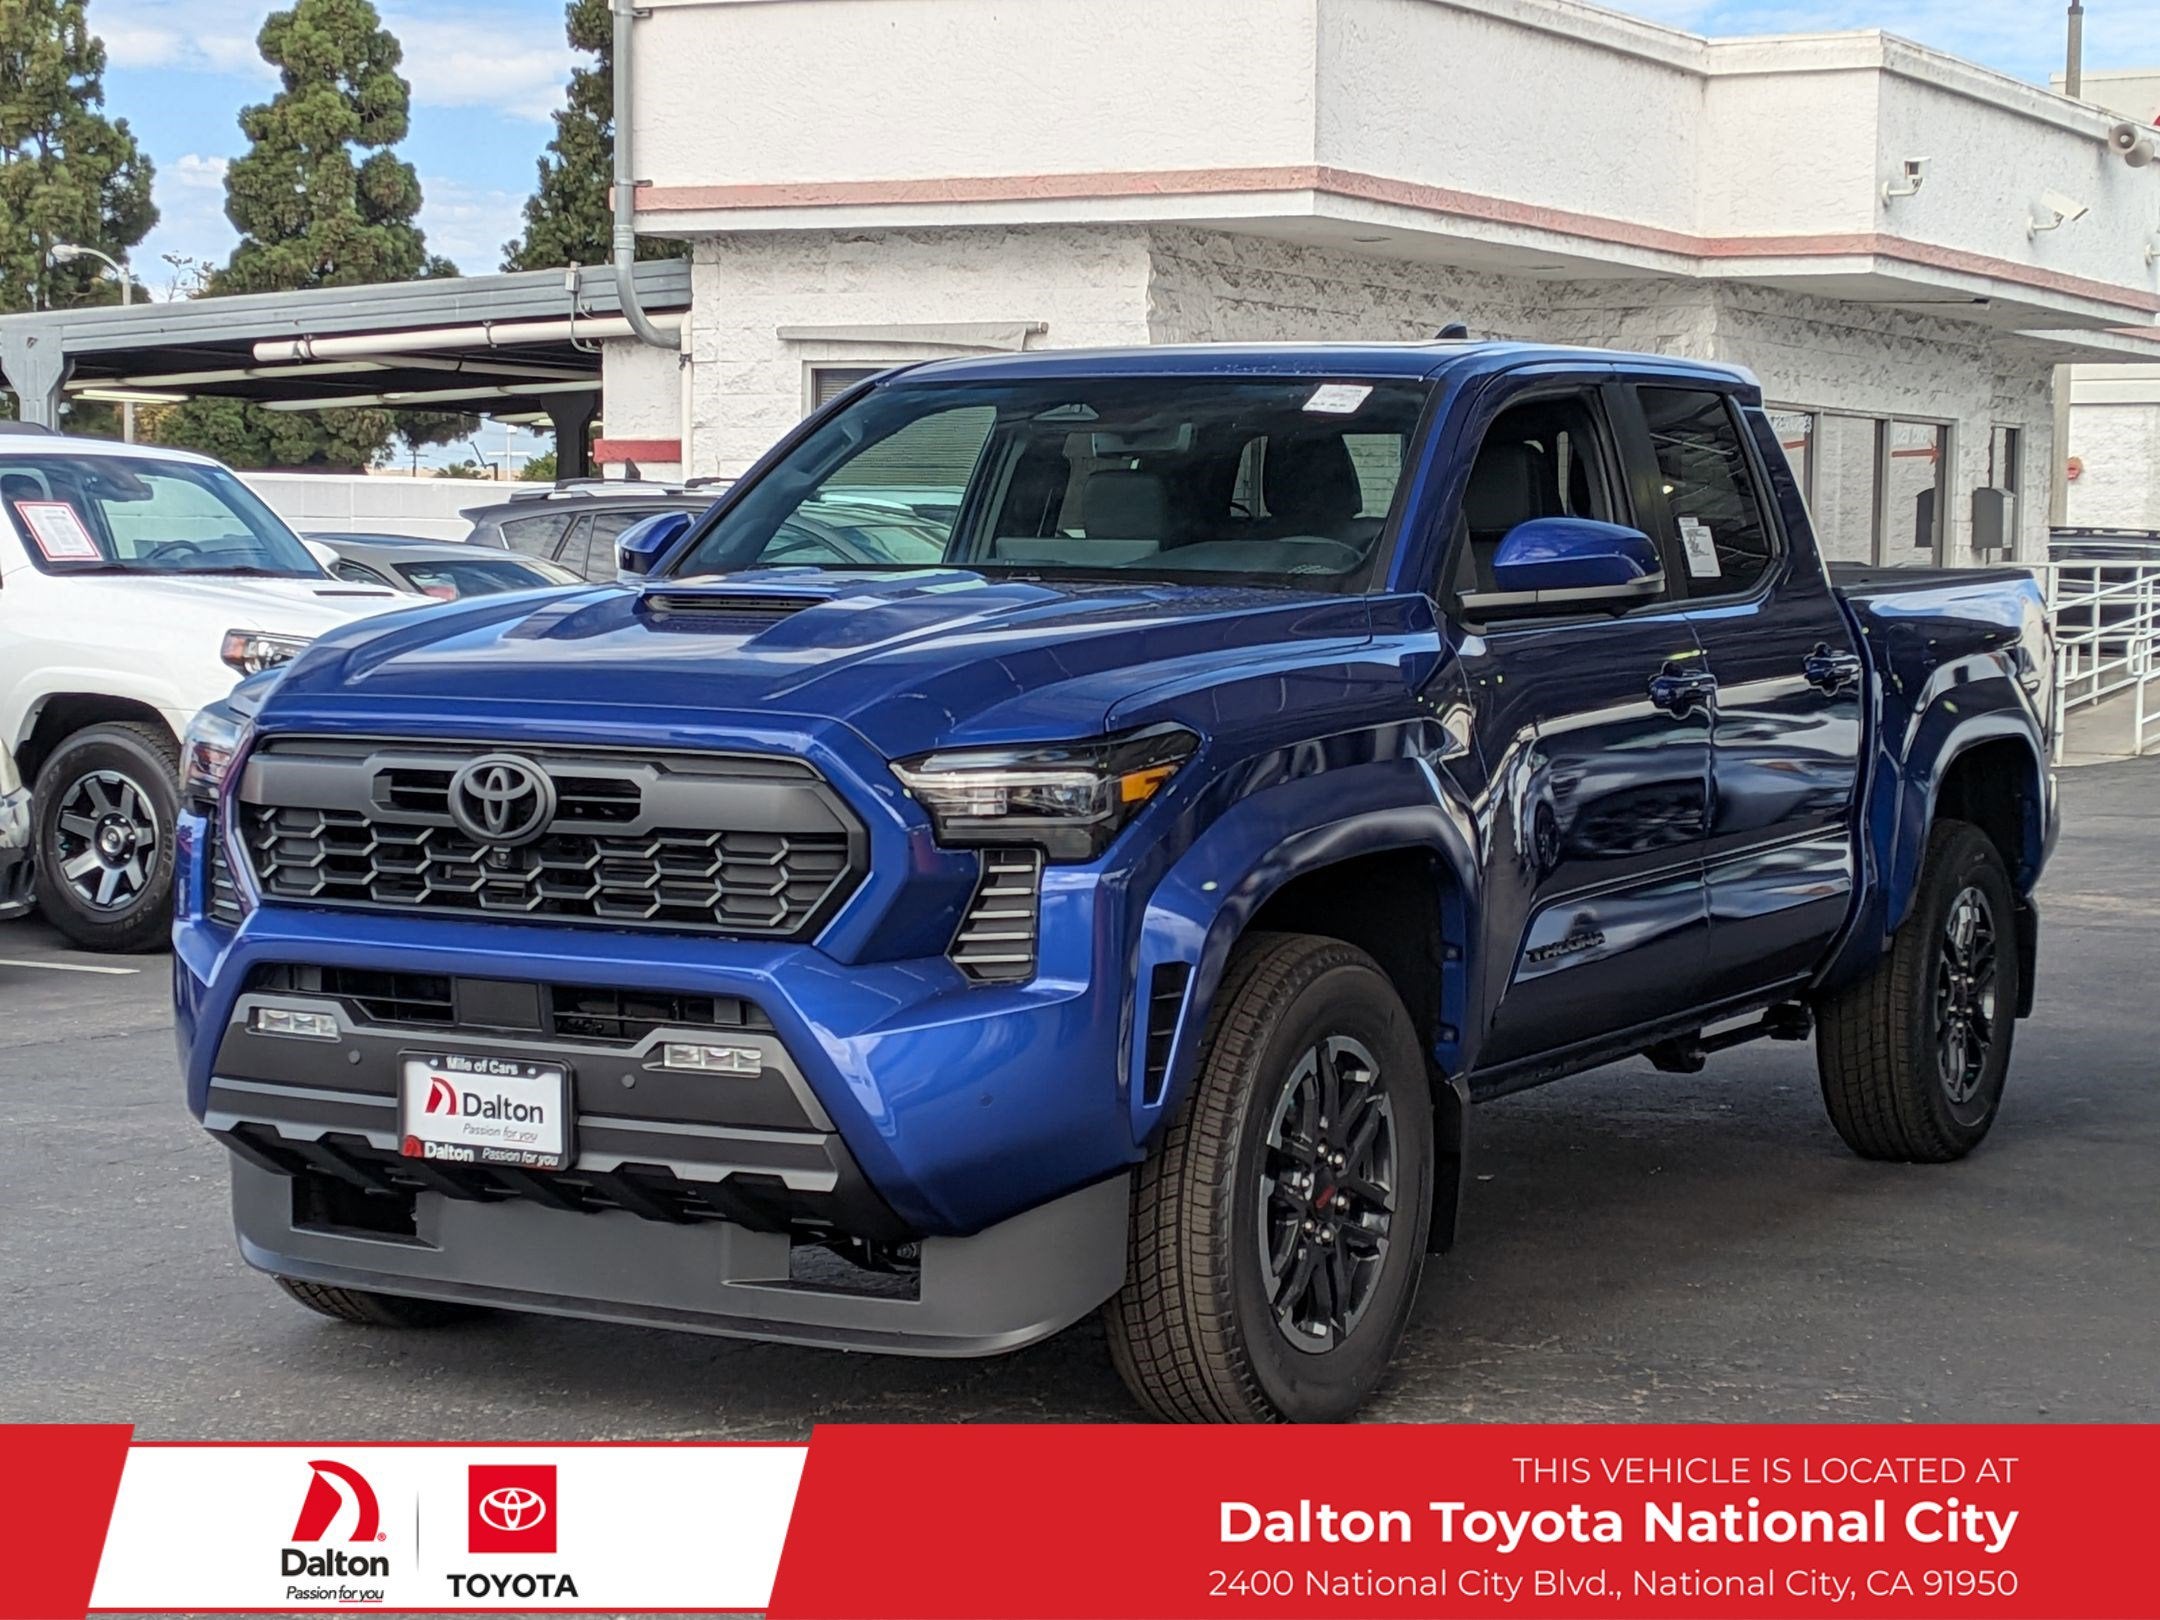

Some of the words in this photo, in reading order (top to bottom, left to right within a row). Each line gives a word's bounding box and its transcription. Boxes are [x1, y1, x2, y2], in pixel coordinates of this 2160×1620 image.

[446, 1056, 473, 1072] Mile
[474, 1060, 487, 1072] of
[489, 1060, 518, 1075] Cars
[463, 1092, 543, 1124] Dalton
[463, 1123, 500, 1136] Passion
[503, 1127, 516, 1138] for
[519, 1132, 538, 1142] you
[424, 1143, 474, 1162] Dalton
[482, 1148, 520, 1162] Passion
[521, 1150, 536, 1163] for
[538, 1155, 559, 1167] you
